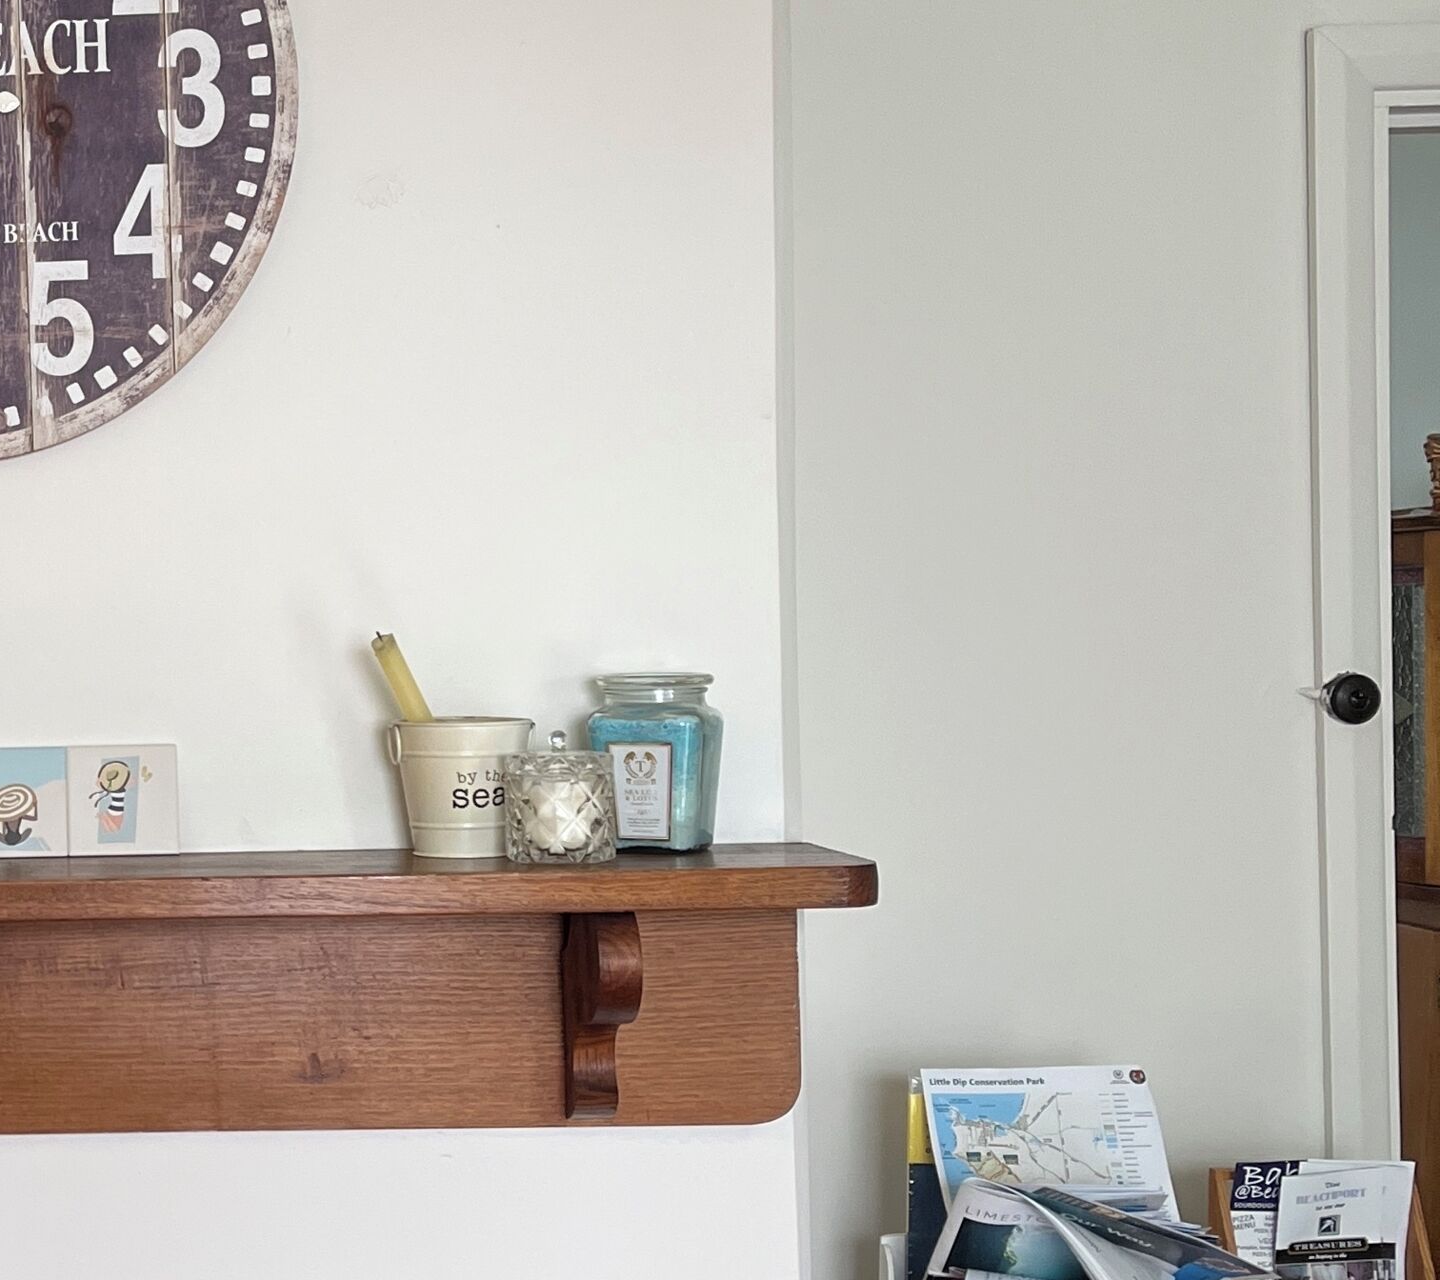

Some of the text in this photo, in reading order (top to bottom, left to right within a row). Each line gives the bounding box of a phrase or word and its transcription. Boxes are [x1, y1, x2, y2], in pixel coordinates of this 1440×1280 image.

[157, 28, 225, 149] 3
[113, 163, 182, 279] 4
[34, 259, 95, 377] 5
[456, 769, 506, 785] by the
[452, 786, 505, 809] sea
[929, 1077, 1045, 1088] Little Dip Conservation Park
[1293, 1240, 1363, 1251] TREASURES
